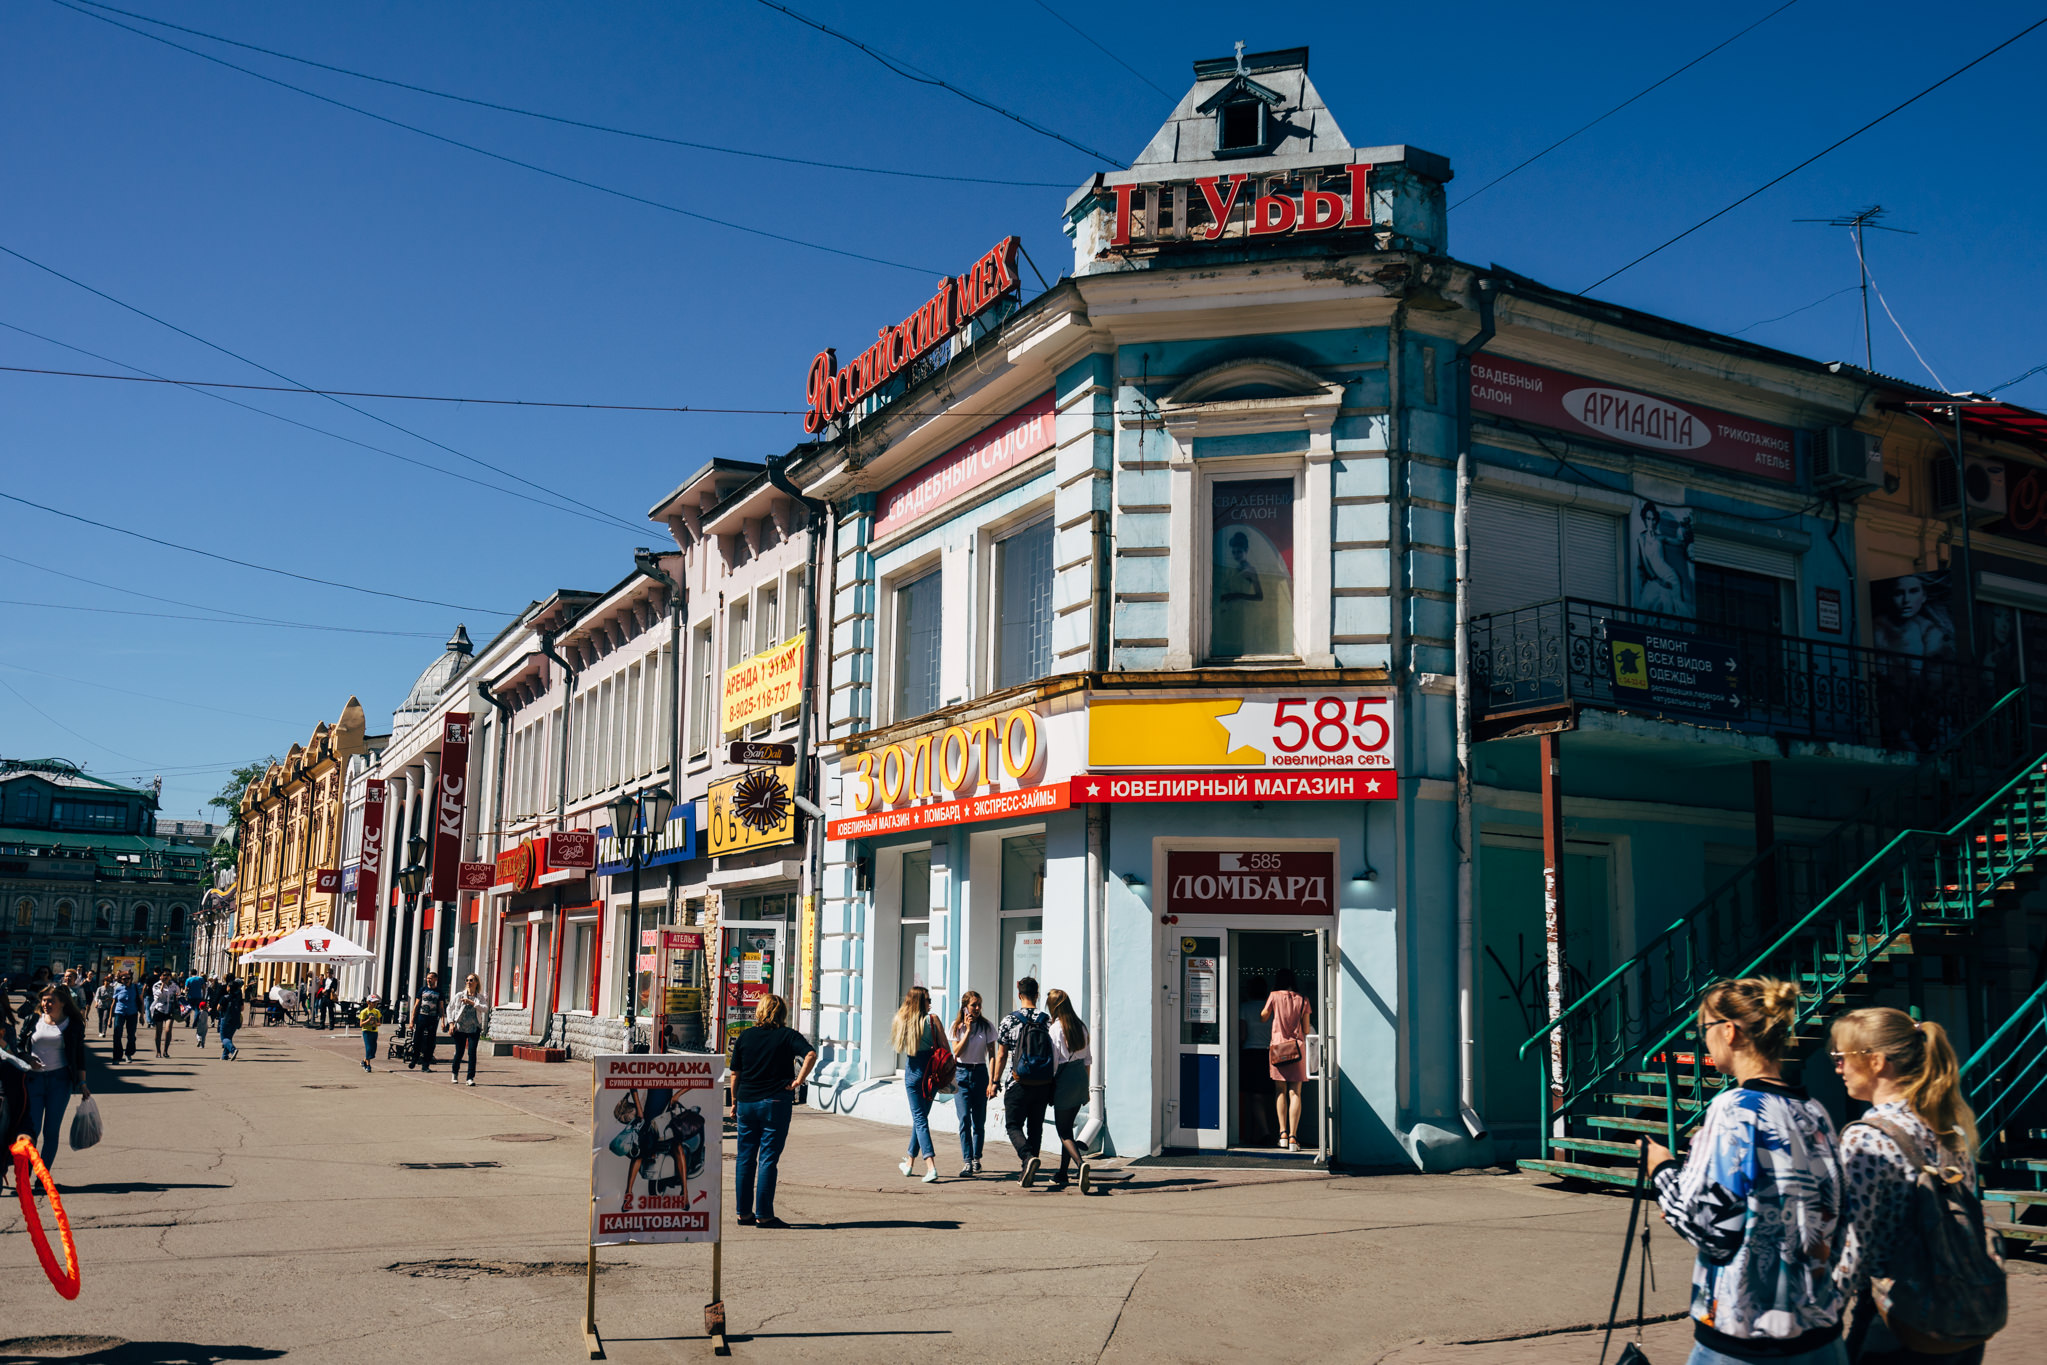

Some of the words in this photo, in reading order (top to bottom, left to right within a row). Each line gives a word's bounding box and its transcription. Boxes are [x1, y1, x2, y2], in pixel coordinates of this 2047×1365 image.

[955, 235, 1013, 327] МЕХ
[1470, 364, 1543, 393] СВАДЕБНЫЙ
[1471, 384, 1513, 405] САЛОН
[1583, 391, 1693, 447] АРИАДНА
[1717, 424, 1791, 453] ТРИКОТАЖНОЕ
[888, 444, 978, 522] СВАДЕБНЫЙ
[981, 411, 1042, 469] САЛОН
[1755, 451, 1791, 470] АТЕЛЬЕ
[1231, 507, 1277, 520] САЛОН
[1646, 635, 1688, 653] РЕМОНТ
[1647, 651, 1675, 666] ВСЕХ
[1677, 657, 1713, 672] ВИДОВ
[726, 667, 758, 698] АРЕНДА
[761, 666, 765, 682] 1
[768, 647, 796, 678] ЭТАЖ
[1649, 667, 1697, 686] ОДЕЖДЫ
[729, 681, 792, 723] 8-9025-118-737
[1272, 696, 1390, 753] 585
[743, 743, 783, 760] SanDali
[855, 708, 1038, 811] ЗОЛОТО
[1272, 755, 1353, 767] ювелирная
[1358, 755, 1390, 765] сеть
[1110, 775, 1248, 797] ЮВЕЛИРНЫЙ
[1254, 777, 1354, 795] МАГАЗИН
[440, 774, 463, 839] KFC
[837, 815, 878, 836] ЮВЕЛИРНЫЙ
[879, 813, 910, 832] МАГАЗИН
[924, 805, 961, 823] ЛОМБАРД
[974, 789, 1057, 817] ЭКСПРЕСС-ЗАЙМЫ
[556, 834, 589, 843] САЛОН
[362, 825, 380, 874] KFC
[464, 863, 491, 871] САЛОН
[1250, 854, 1281, 869] 585
[321, 875, 337, 886] GJ
[1172, 875, 1328, 907] ЛОМБАРД
[672, 934, 696, 944] АТЕЛЬЕ
[610, 1061, 712, 1077] РАСПРОДАЖА
[609, 1079, 632, 1087] СУМОК
[633, 1079, 643, 1087] ИЗ
[643, 1078, 689, 1087] НАТУРАЛЬНОЙ
[623, 1193, 634, 1209] 2
[637, 1195, 685, 1209] этаж
[604, 1215, 704, 1231] КАНЦТОВАРЫ
